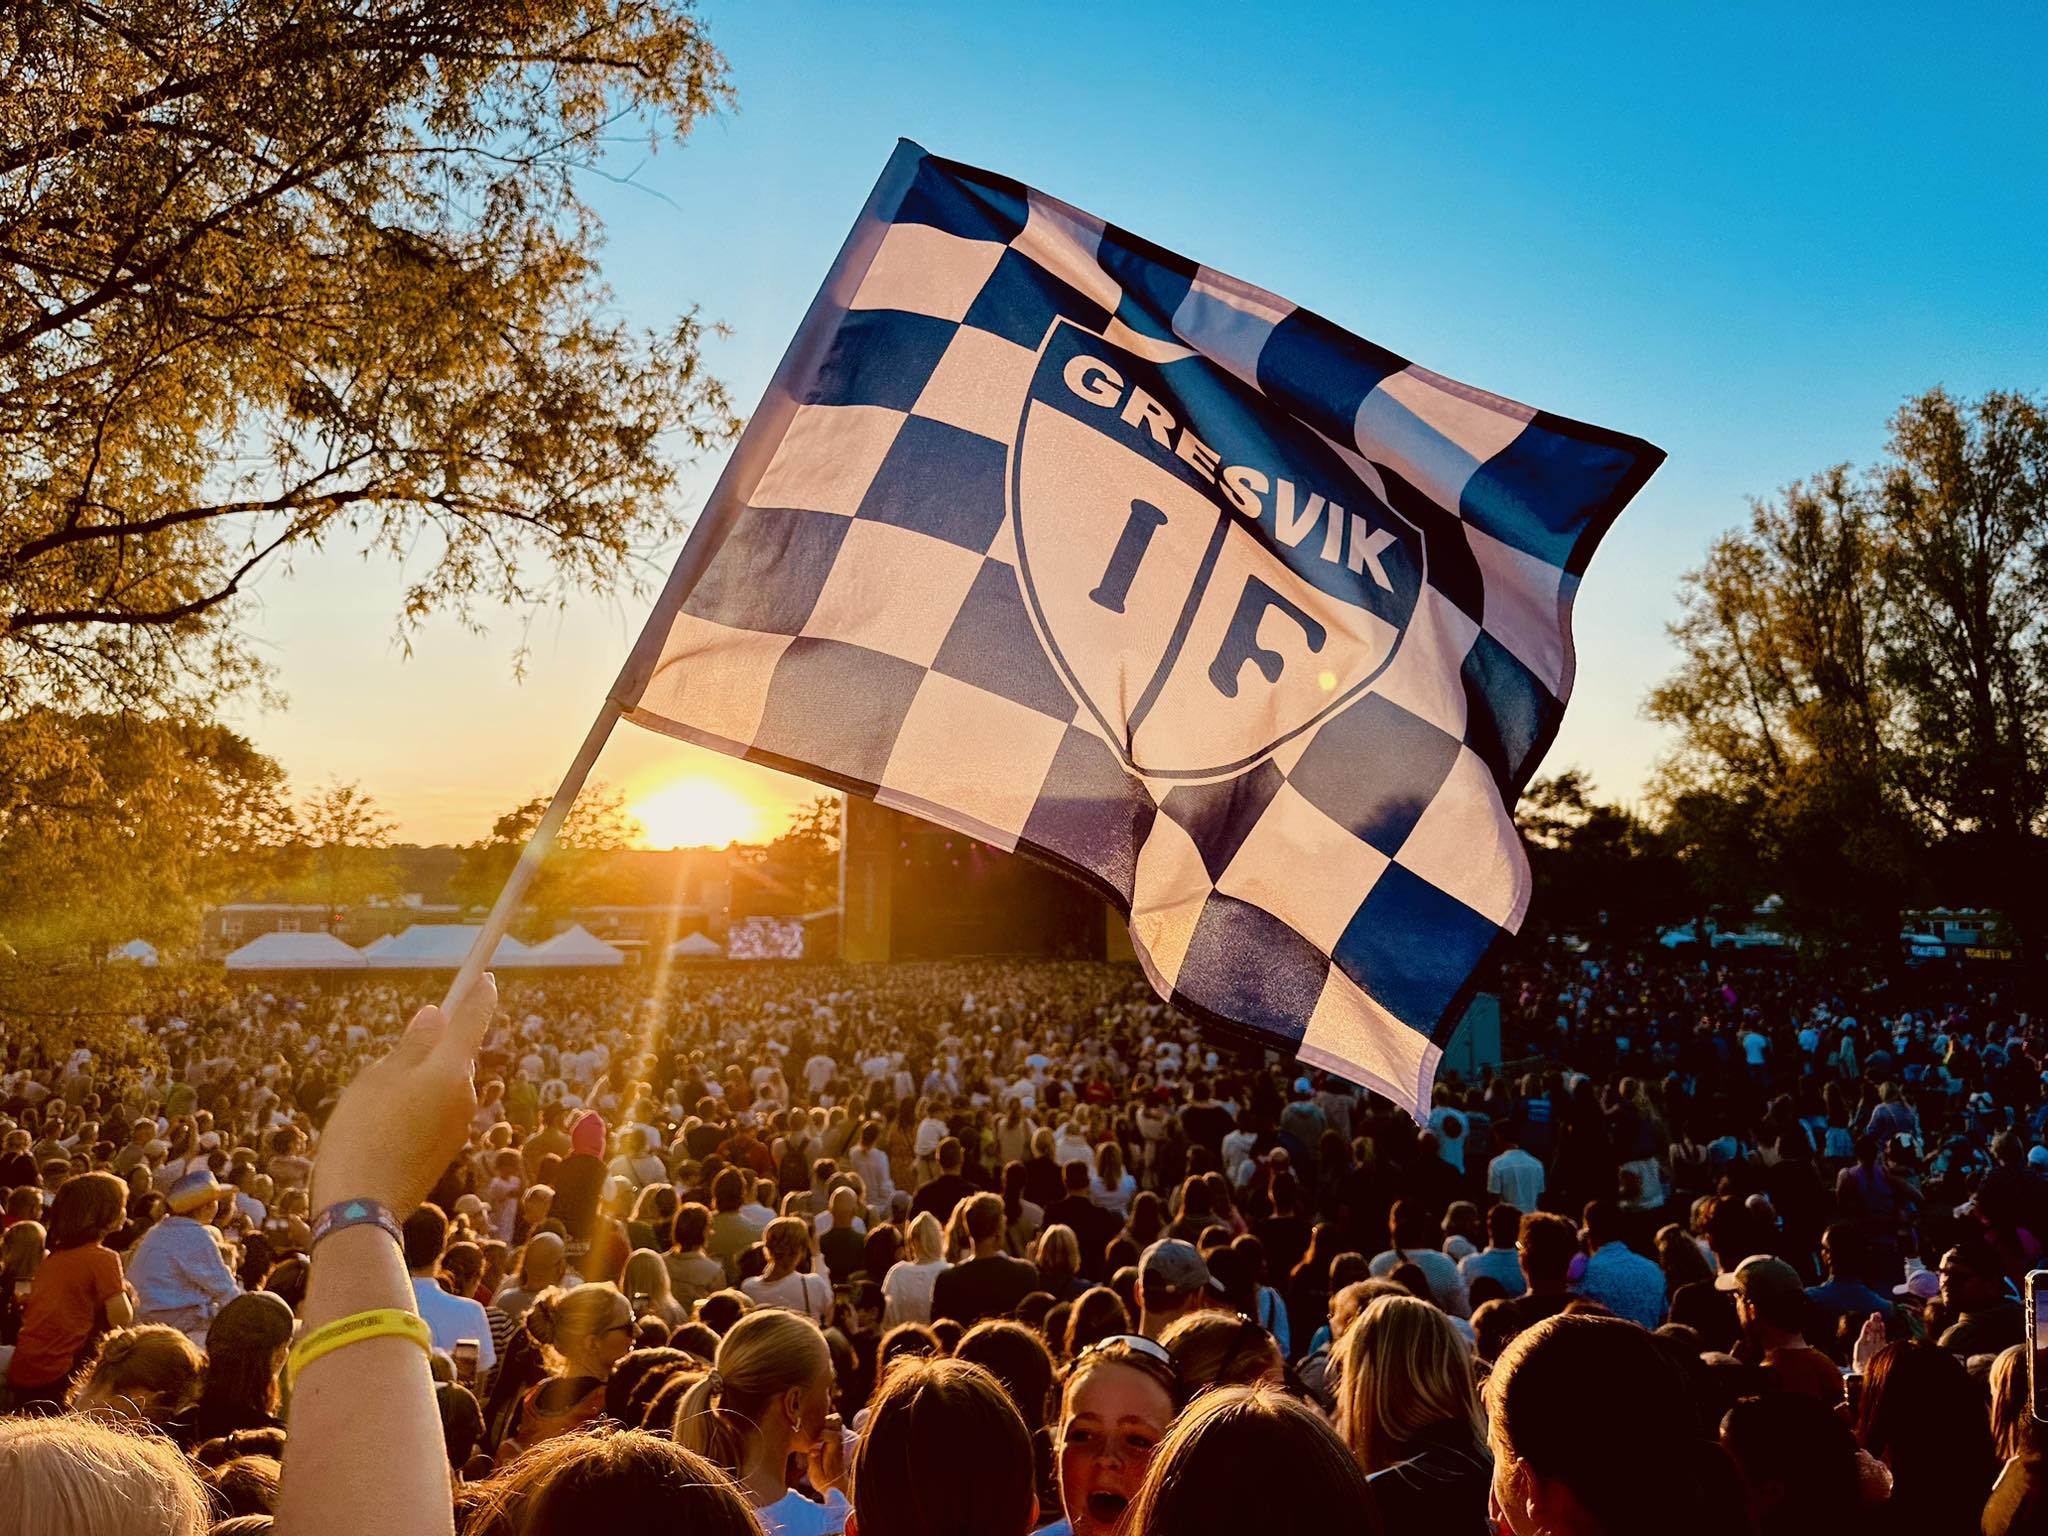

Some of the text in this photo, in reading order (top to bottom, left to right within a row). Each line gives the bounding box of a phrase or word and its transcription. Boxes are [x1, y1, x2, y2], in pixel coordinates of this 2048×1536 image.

[1063, 355, 1397, 593] GRESVIK
[1090, 499, 1326, 698] I F
